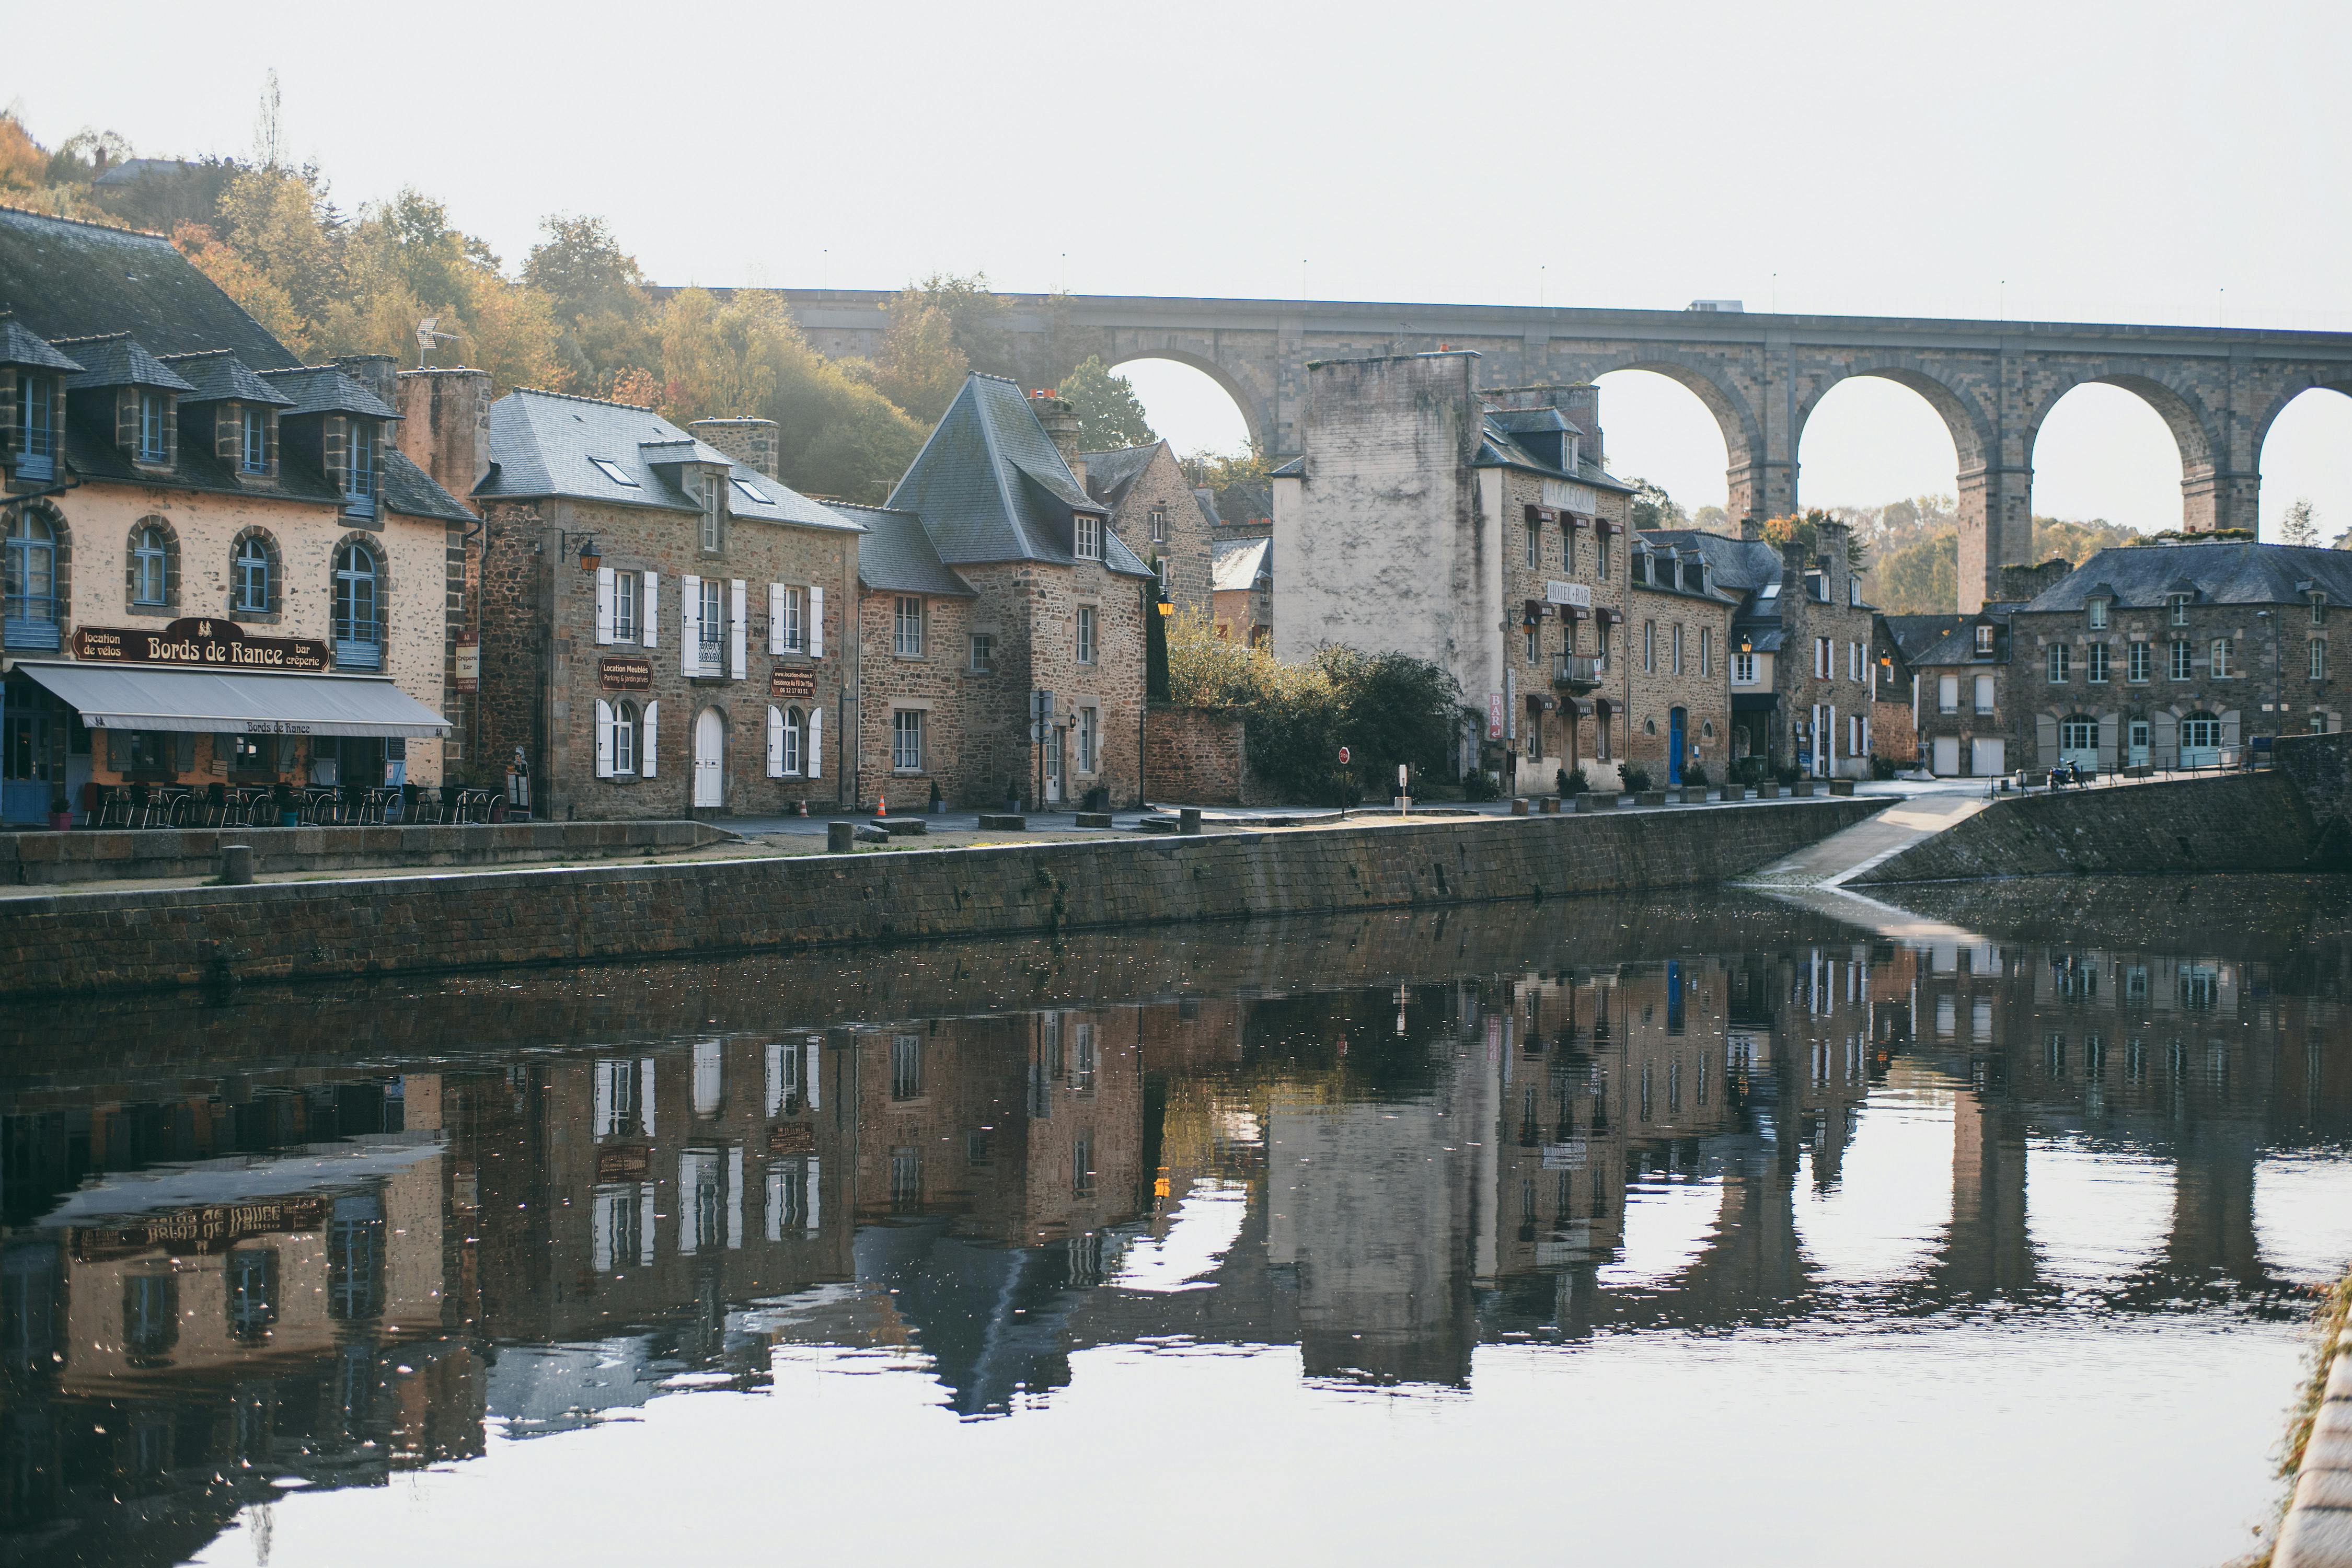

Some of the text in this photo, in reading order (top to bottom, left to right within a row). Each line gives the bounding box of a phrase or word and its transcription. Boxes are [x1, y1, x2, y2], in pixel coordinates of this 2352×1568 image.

[1544, 482, 1595, 509] HARLEQUIN
[1550, 584, 1589, 604] HOTEL BAR
[85, 632, 120, 644] location
[84, 644, 121, 656] de vélos
[148, 637, 283, 664] Bords de Rance
[295, 643, 310, 654] bar
[286, 656, 319, 667] crêperie
[627, 665, 648, 674] Meublés
[604, 674, 620, 683] Parking
[1491, 696, 1500, 725] BAR
[247, 722, 310, 733] Bords de Rance
